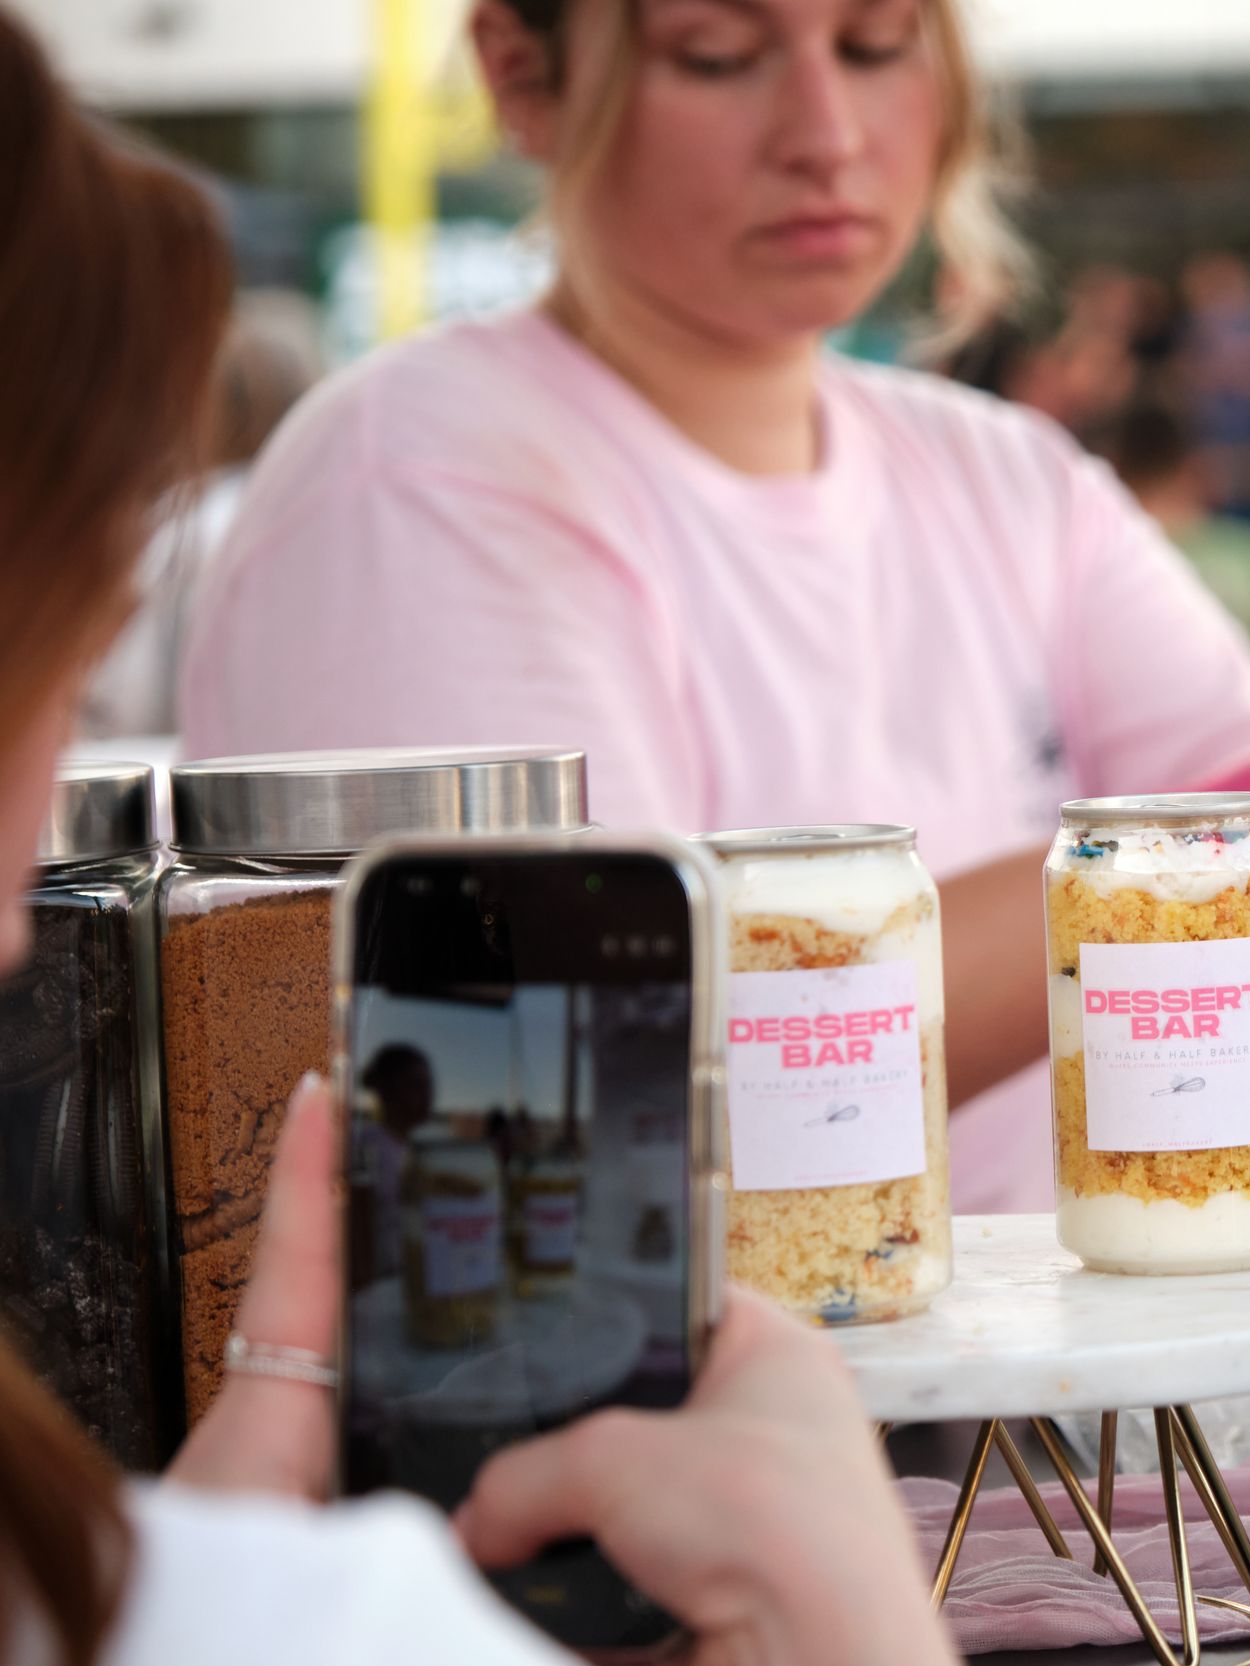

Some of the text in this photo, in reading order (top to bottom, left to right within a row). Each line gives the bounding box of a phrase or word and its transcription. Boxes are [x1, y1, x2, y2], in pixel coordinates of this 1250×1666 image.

[728, 1005, 915, 1043] DESSERT
[1131, 1014, 1221, 1040] BAR
[781, 1039, 874, 1070] BAR
[1095, 1050, 1109, 1060] BY
[1114, 1049, 1146, 1060] HALF
[1154, 1050, 1161, 1060] &
[1169, 1048, 1202, 1059] HALF
[762, 1078, 799, 1091] HALF
[821, 1076, 857, 1088] HALF
